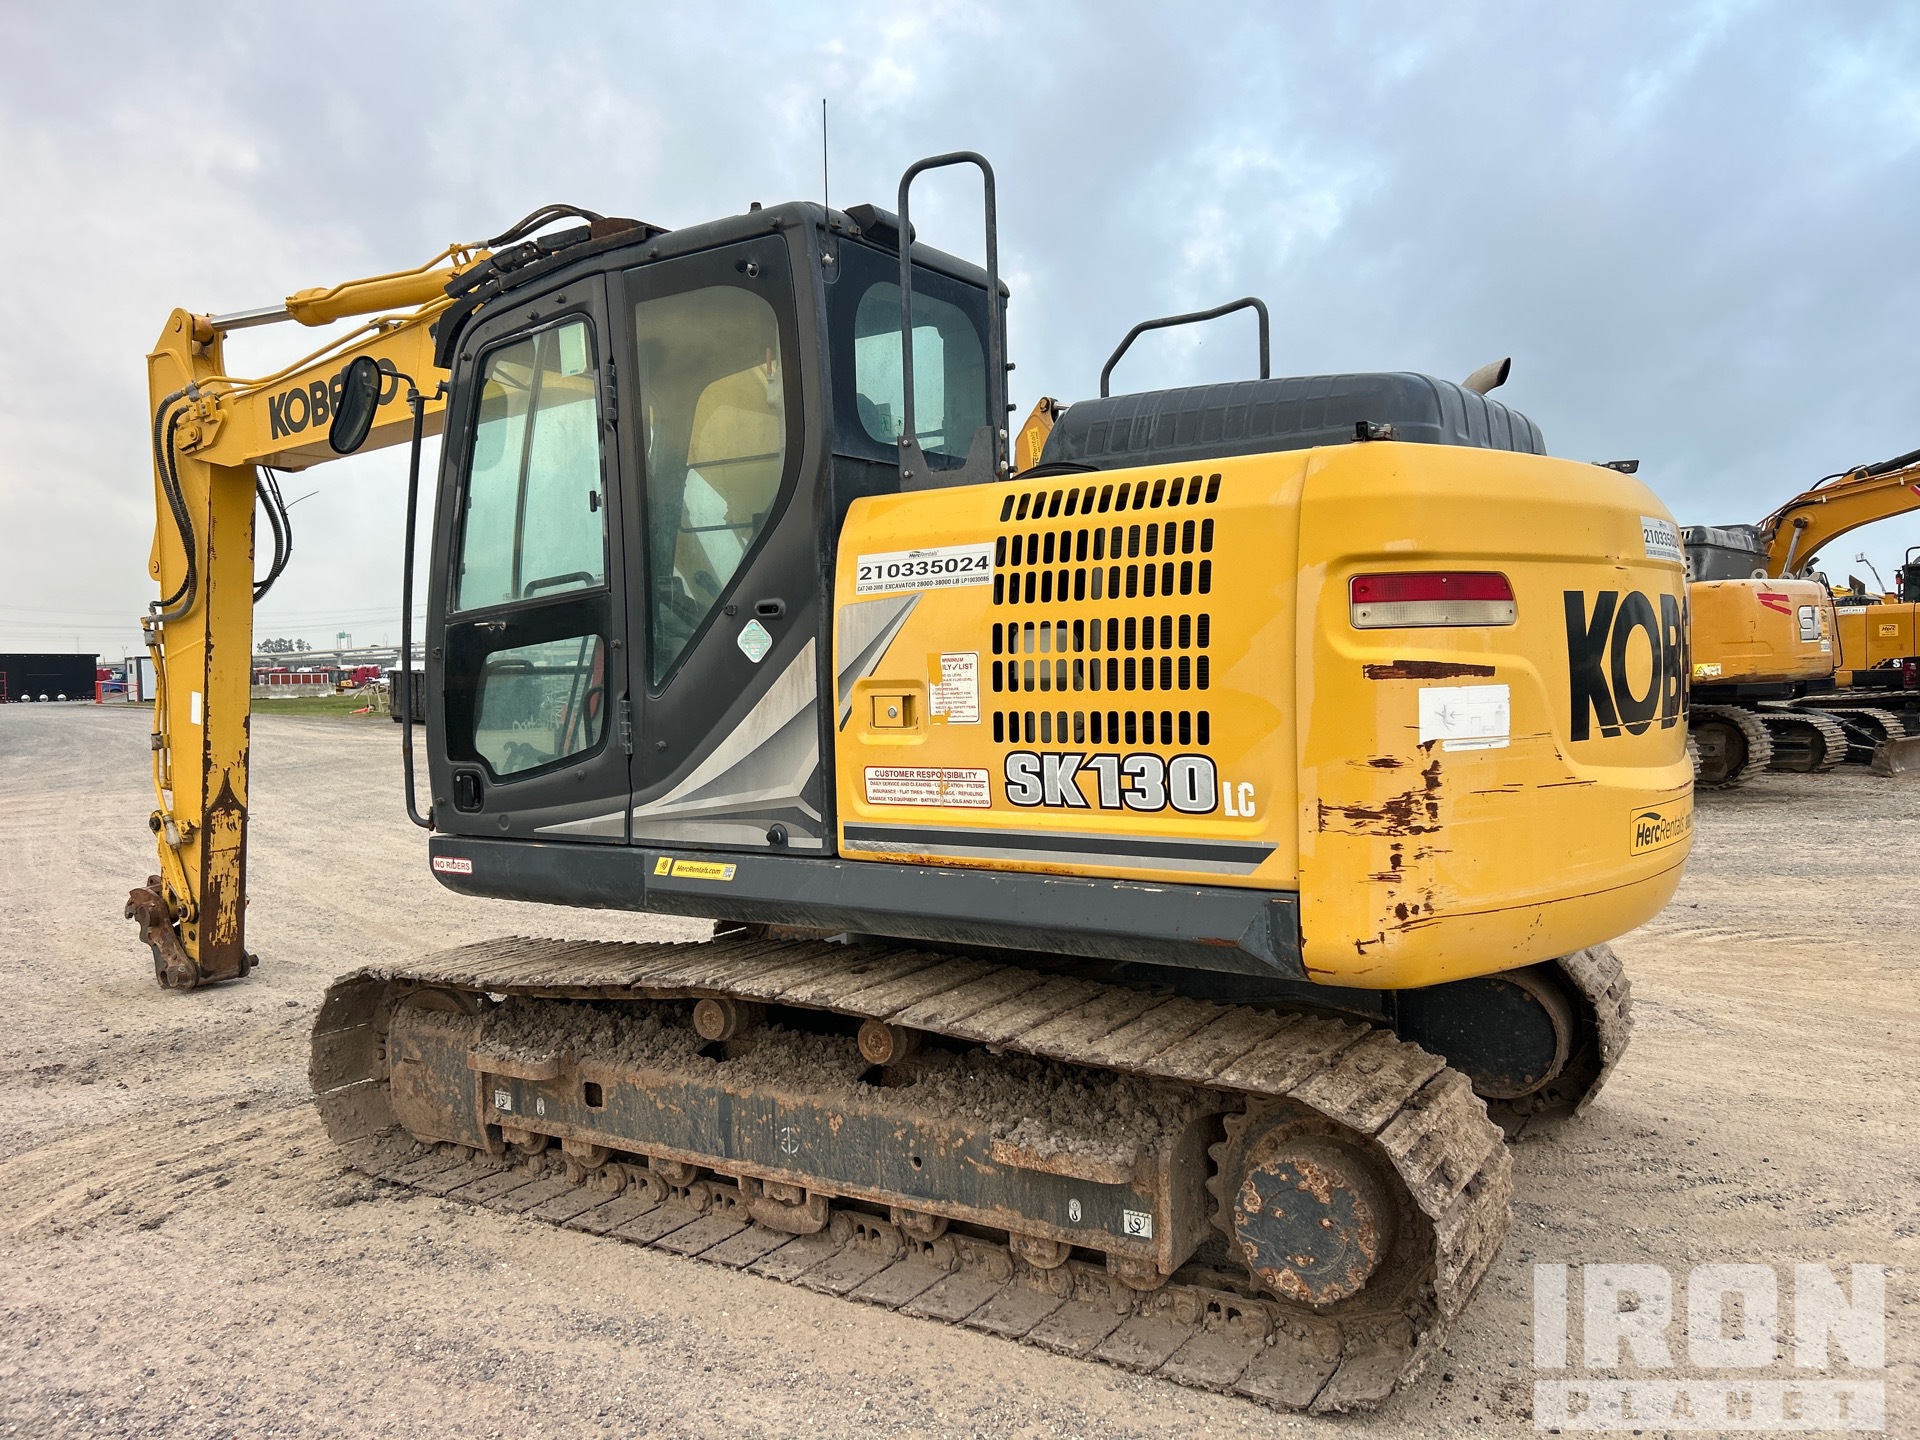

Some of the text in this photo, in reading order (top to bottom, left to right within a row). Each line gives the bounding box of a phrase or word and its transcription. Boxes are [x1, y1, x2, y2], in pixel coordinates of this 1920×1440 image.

[268, 358, 399, 440] KOBEO
[859, 555, 990, 581] 210335024
[885, 581, 916, 590] EXCAVATOR
[917, 771, 977, 779] RESPONSIBILITY
[1004, 750, 1255, 818] SK130 LC
[435, 860, 470, 870] NO RIDERS
[676, 865, 721, 874] HercRentals.com
